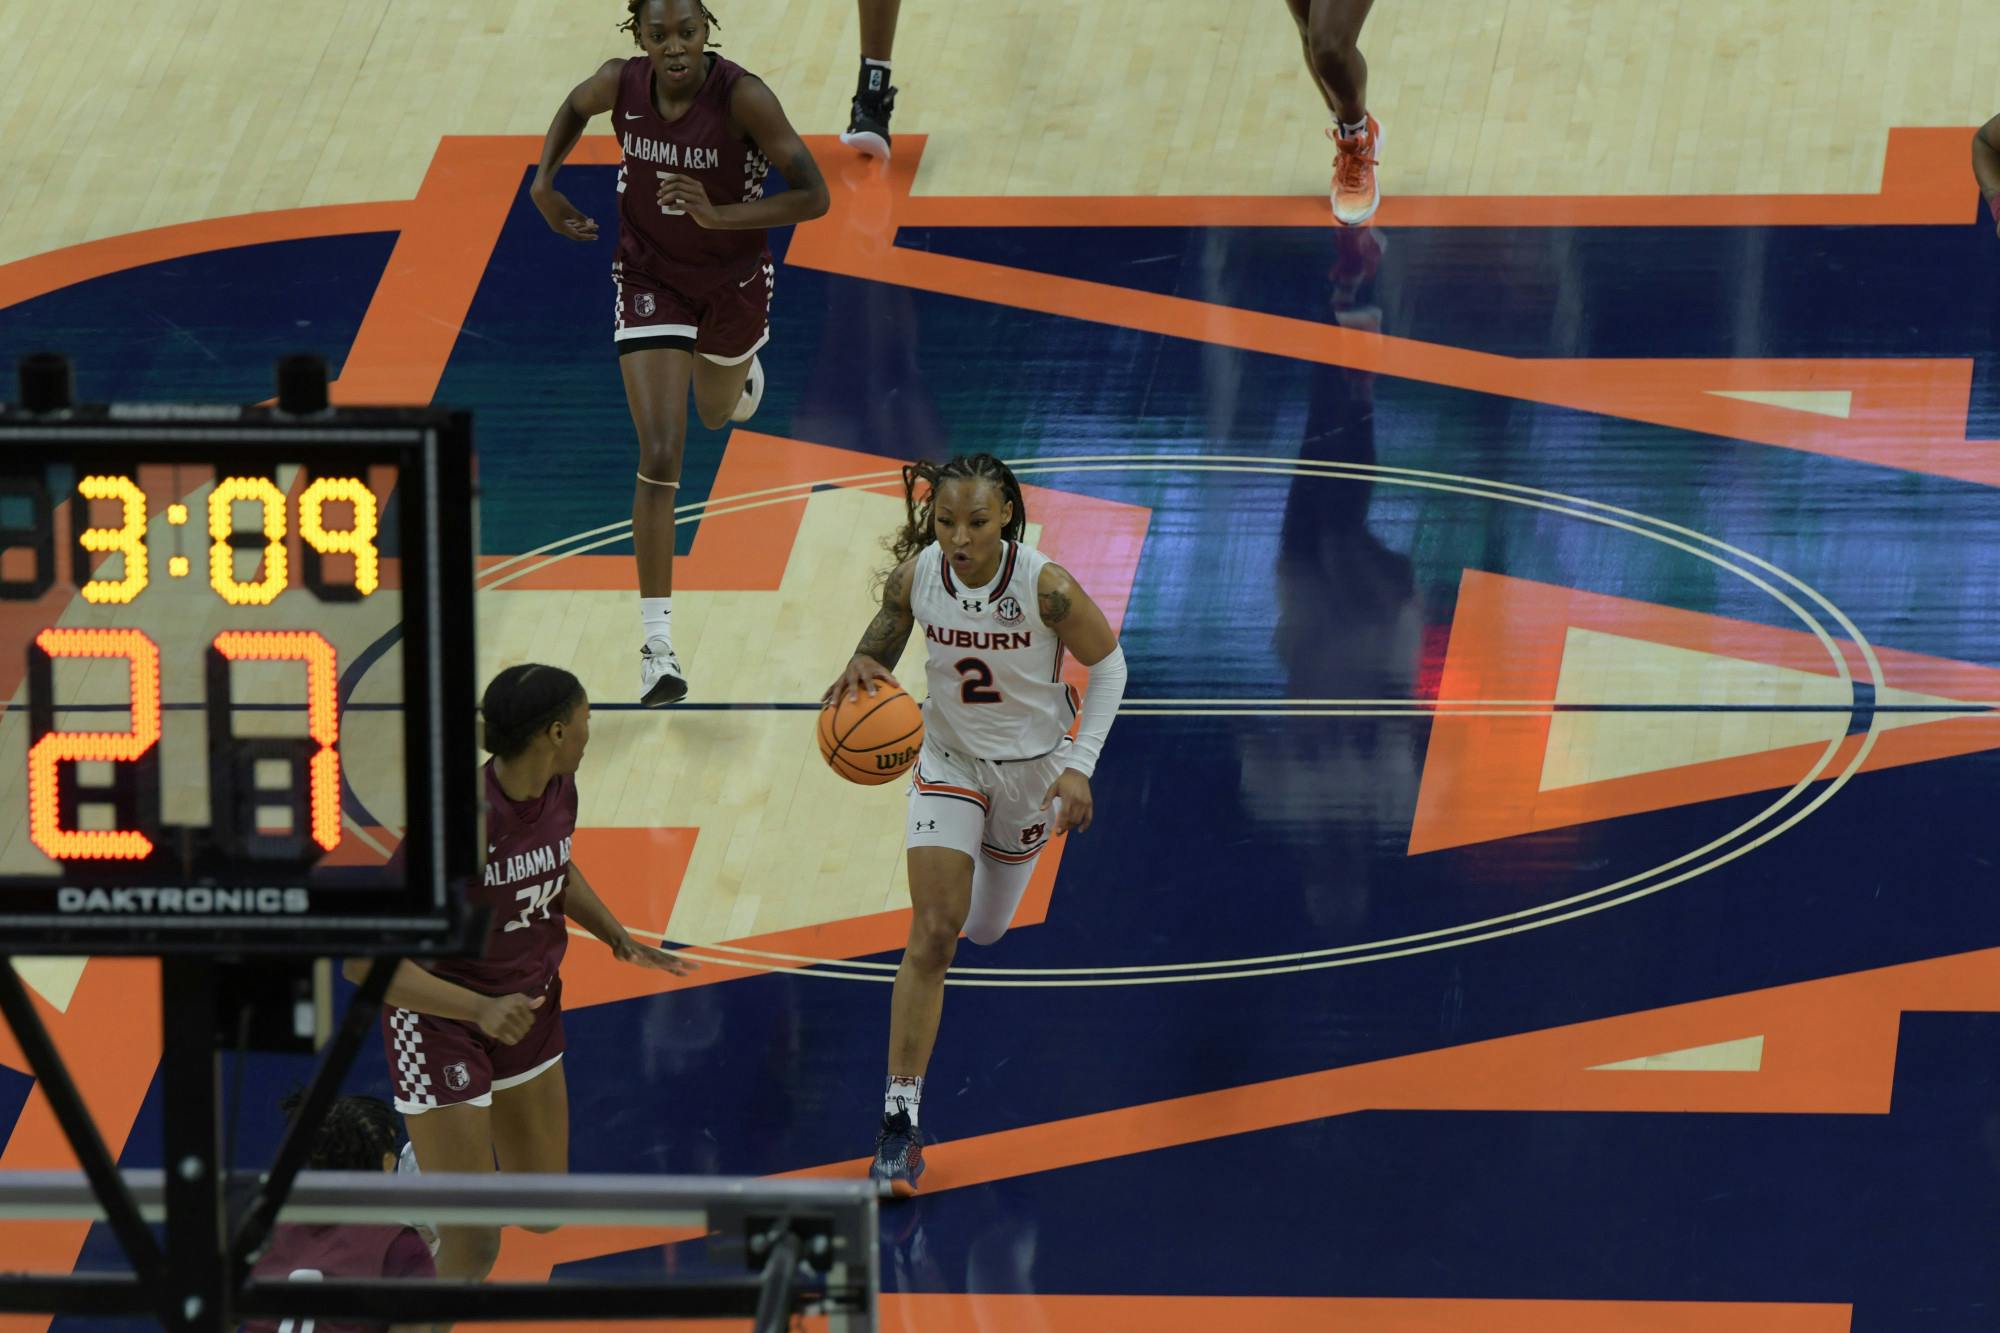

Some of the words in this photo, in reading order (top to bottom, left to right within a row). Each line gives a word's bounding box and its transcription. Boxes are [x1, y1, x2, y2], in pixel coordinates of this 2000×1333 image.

[623, 131, 678, 167] ALABAMA
[683, 146, 719, 169] A&M
[79, 475, 378, 605] 3:09
[925, 623, 1033, 651] AUBURN
[953, 656, 1003, 705] 2
[29, 628, 341, 860] 27
[483, 845, 556, 887] ALABAMA
[57, 886, 309, 914] DAKTRONICS
